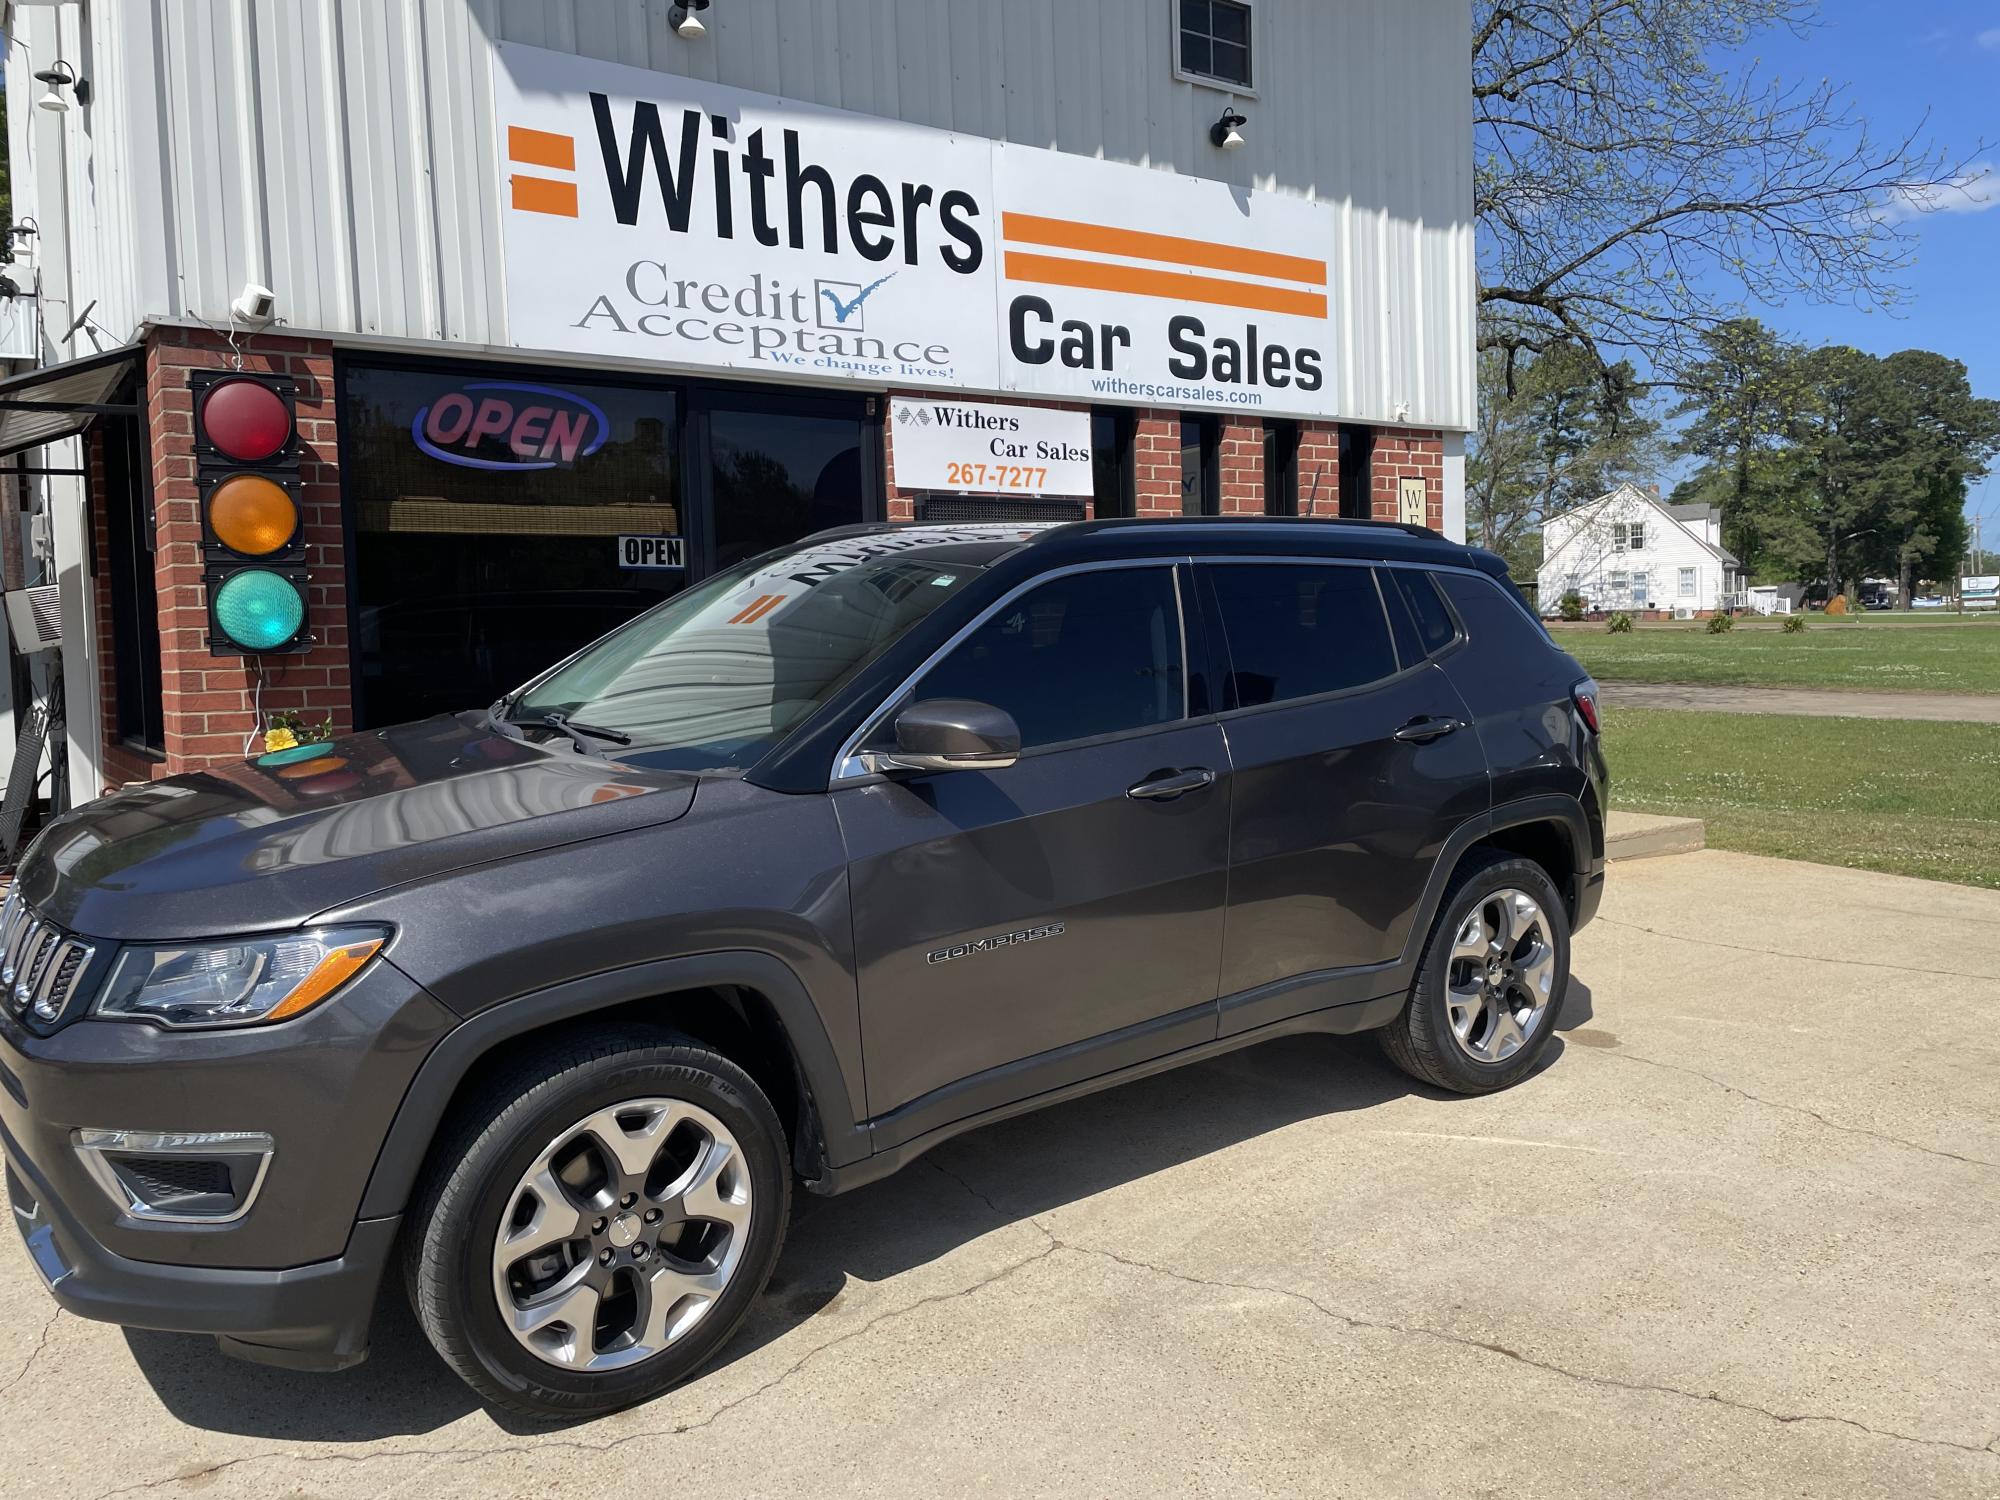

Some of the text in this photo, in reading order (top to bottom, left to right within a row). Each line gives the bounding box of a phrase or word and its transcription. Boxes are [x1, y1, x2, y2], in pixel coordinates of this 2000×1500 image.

[589, 91, 983, 275] Withers
[625, 259, 809, 324] Credit
[570, 294, 950, 366] Acceptance
[1009, 294, 1323, 392] Car Sales
[771, 351, 955, 380] We change lives!
[1091, 376, 1262, 405] witherscarsales.com
[426, 393, 590, 463] OPEN
[933, 406, 1019, 431] Withers
[989, 437, 1090, 462] Car Sales
[947, 462, 1047, 488] 267-7277
[624, 538, 681, 566] OPEN
[926, 922, 1065, 965] COMPASS
